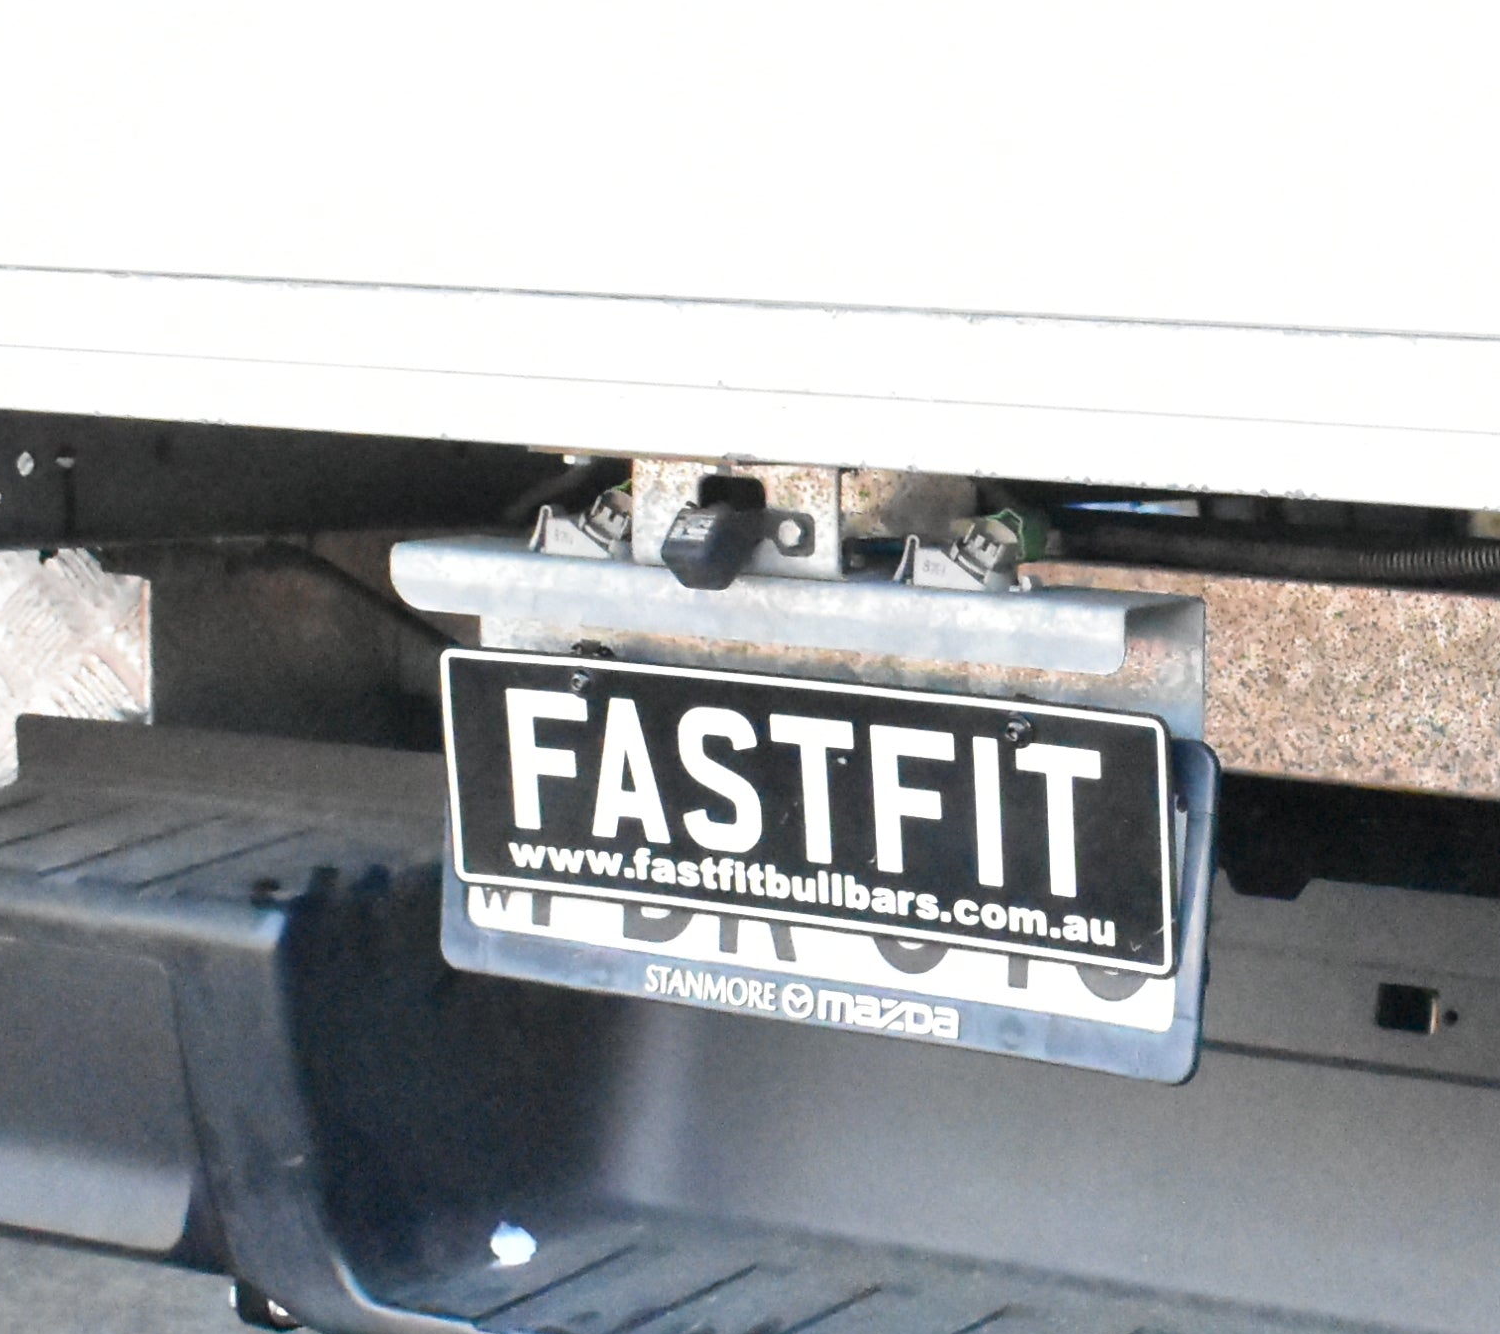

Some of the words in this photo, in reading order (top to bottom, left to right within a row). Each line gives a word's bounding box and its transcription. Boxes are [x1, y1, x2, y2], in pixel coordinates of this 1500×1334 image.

[505, 687, 1102, 899] FASTFIT
[508, 840, 1116, 948] www.fastfitbullbars.com.au
[644, 964, 777, 1012] STANMORE
